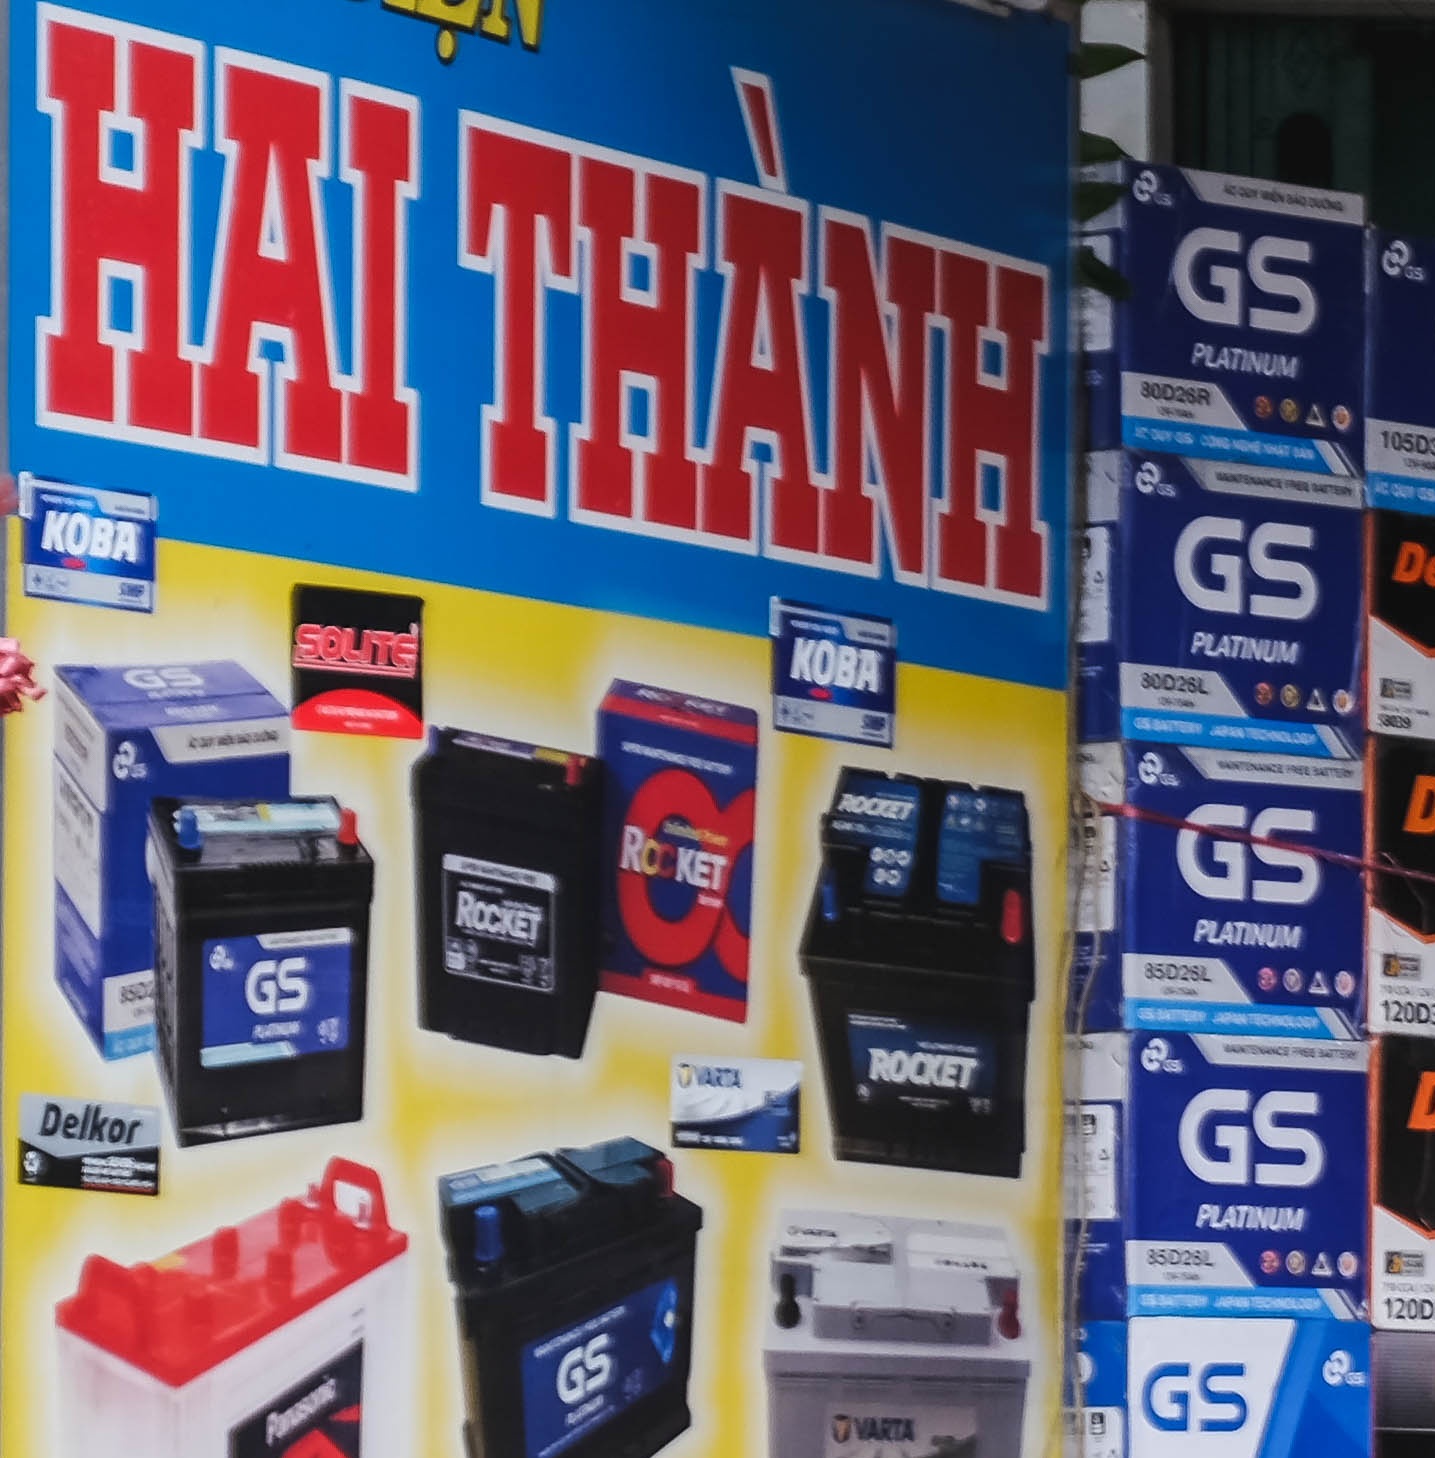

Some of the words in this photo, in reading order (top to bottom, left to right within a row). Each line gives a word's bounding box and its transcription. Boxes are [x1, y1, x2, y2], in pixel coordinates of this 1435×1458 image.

[36, 2, 421, 492] HAI
[458, 67, 1050, 610] THÀNH
[294, 623, 419, 670] SOLITE
[790, 637, 881, 693] KOBA
[1193, 919, 1301, 949] PLATINUM
[868, 1047, 978, 1090] ROCKET
[39, 1102, 143, 1145] Delkor
[266, 1377, 337, 1445] Panasonic
[854, 1415, 916, 1445] VARTA
